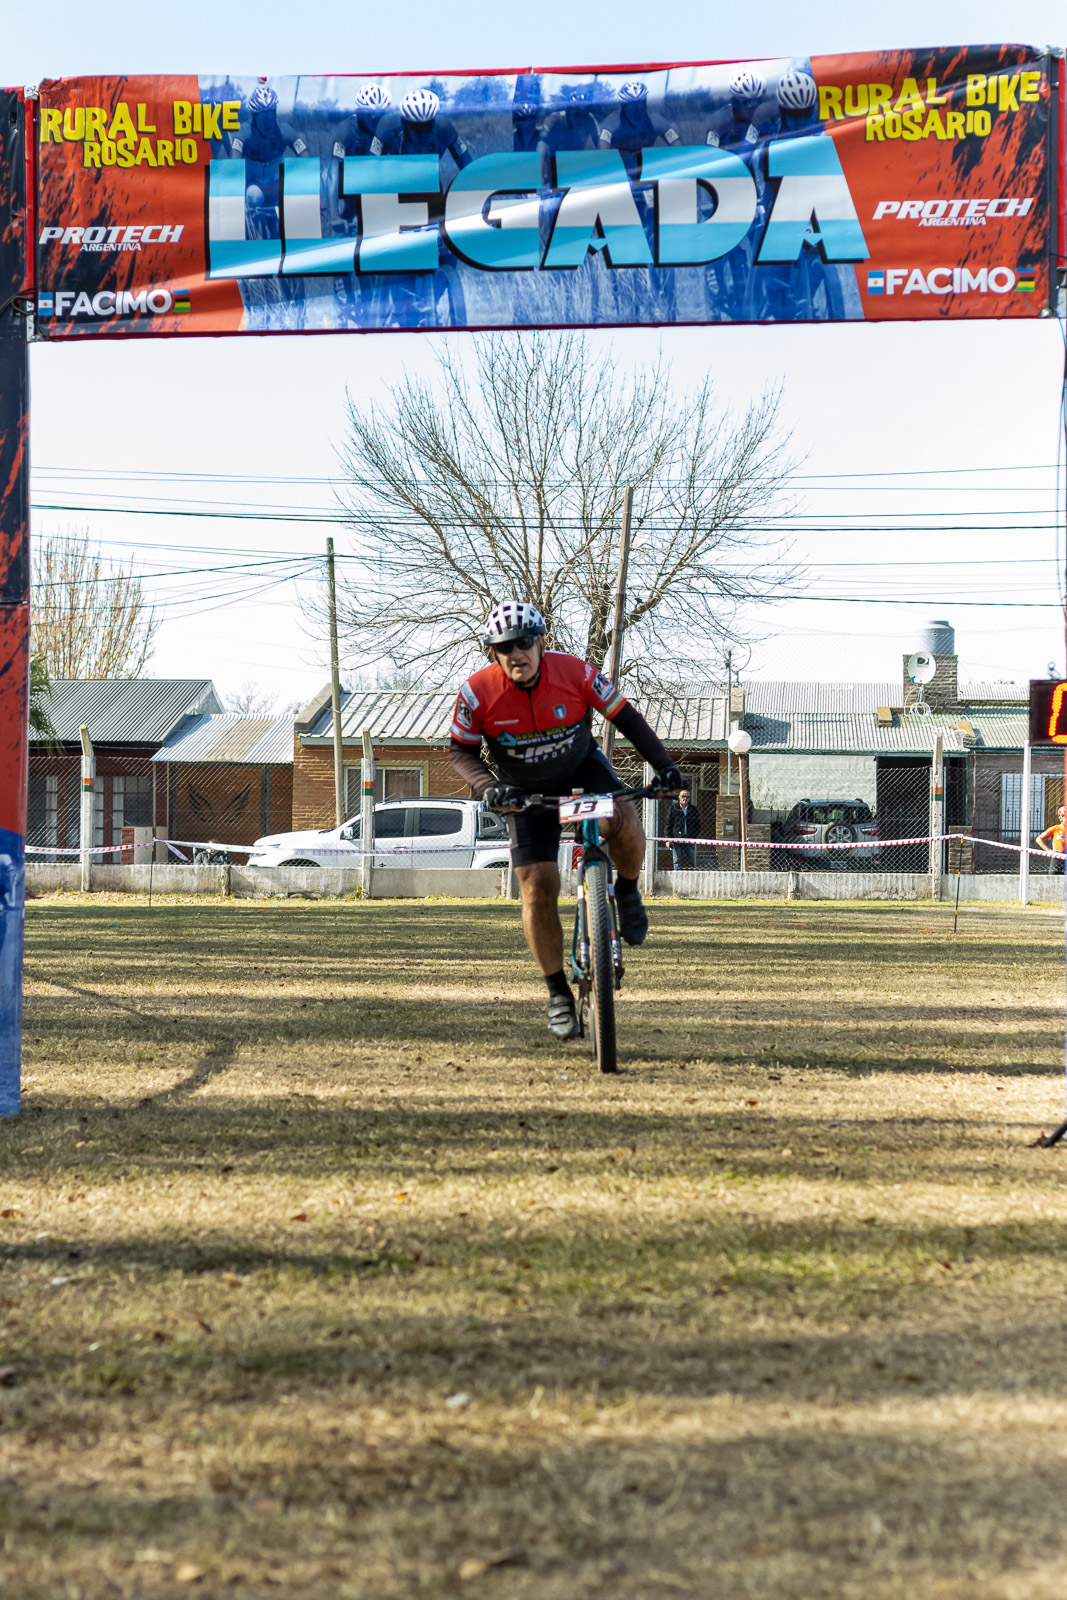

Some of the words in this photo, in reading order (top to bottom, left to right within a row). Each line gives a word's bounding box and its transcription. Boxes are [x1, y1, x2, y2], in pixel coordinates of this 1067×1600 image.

[818, 77, 946, 120] RURAL
[966, 71, 1040, 112] BIKE
[40, 102, 157, 143] RURAL
[173, 101, 241, 140] BIKE
[865, 109, 991, 141] ROSARIO
[83, 137, 198, 168] ROSARIO
[206, 136, 870, 277] LLEGADA
[872, 198, 1034, 220] PROTECH
[38, 225, 184, 244] PROTECH
[918, 217, 987, 227] ARGENTINA
[80, 242, 142, 252] ARGENTINA
[886, 266, 1016, 295] FACIMO
[55, 289, 172, 316] FACIMO
[573, 800, 598, 815] 13
